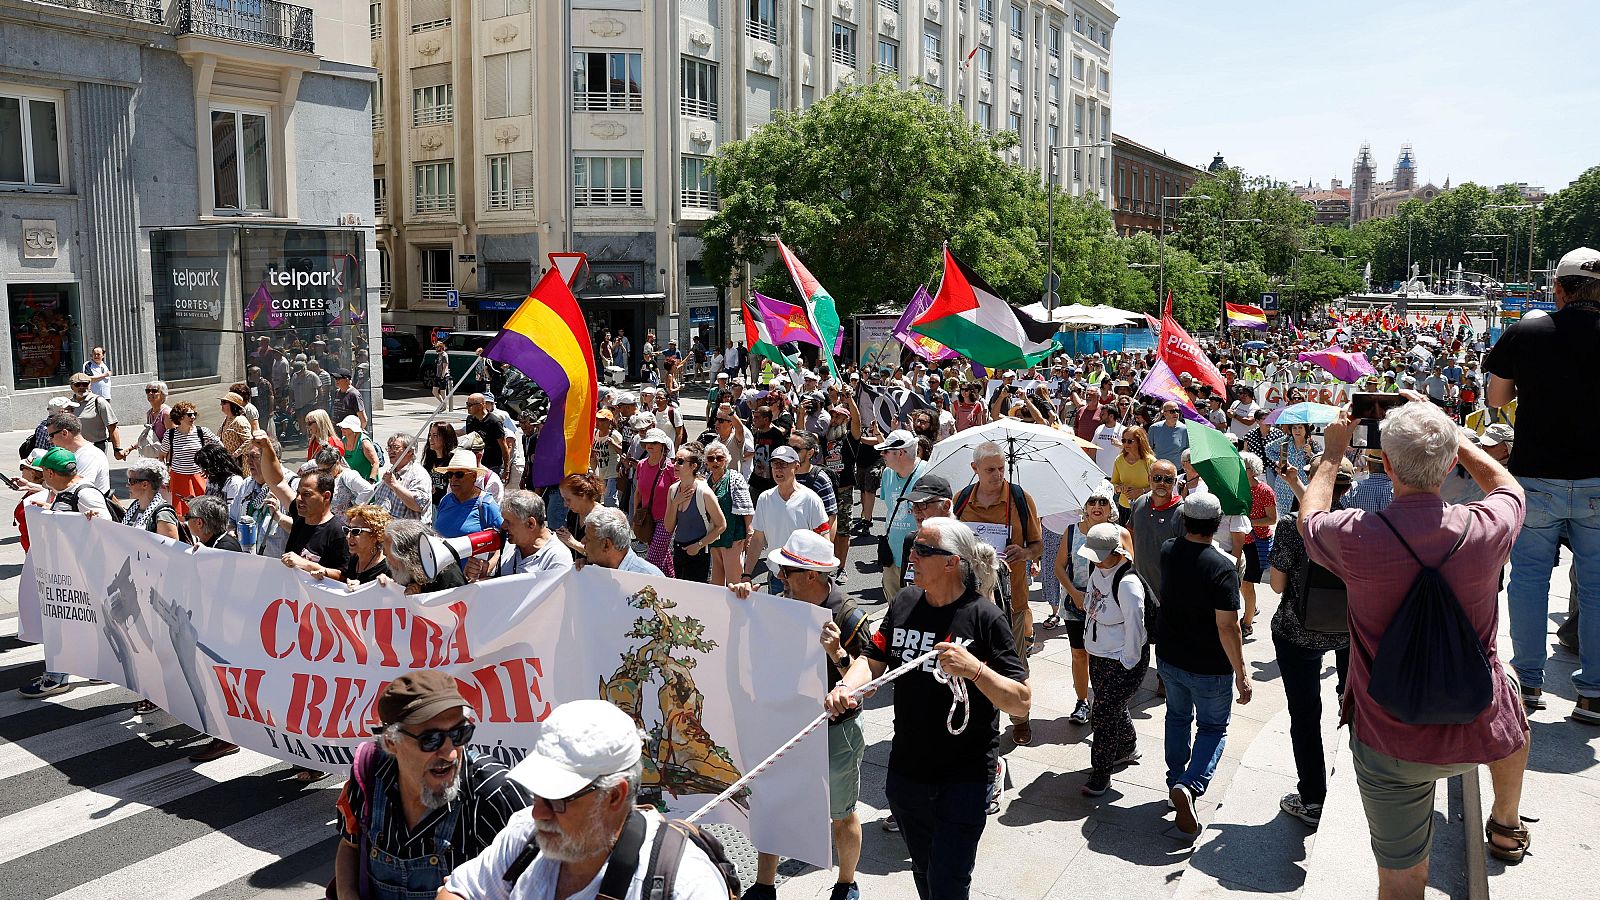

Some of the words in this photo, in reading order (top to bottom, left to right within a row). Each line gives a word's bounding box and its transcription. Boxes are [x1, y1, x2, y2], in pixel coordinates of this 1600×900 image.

[173, 268, 219, 291] telpark
[269, 267, 343, 290] telpark
[175, 299, 208, 310] CORTES
[271, 298, 324, 309] CORTES
[1263, 295, 1274, 309] P
[48, 573, 72, 586] MADRID
[46, 587, 55, 601] EL
[56, 588, 91, 606] REARME
[259, 598, 474, 668] CONTRA
[890, 649, 901, 658] THE
[213, 665, 276, 725] EL
[264, 726, 279, 749] Y
[281, 733, 312, 760] LA
